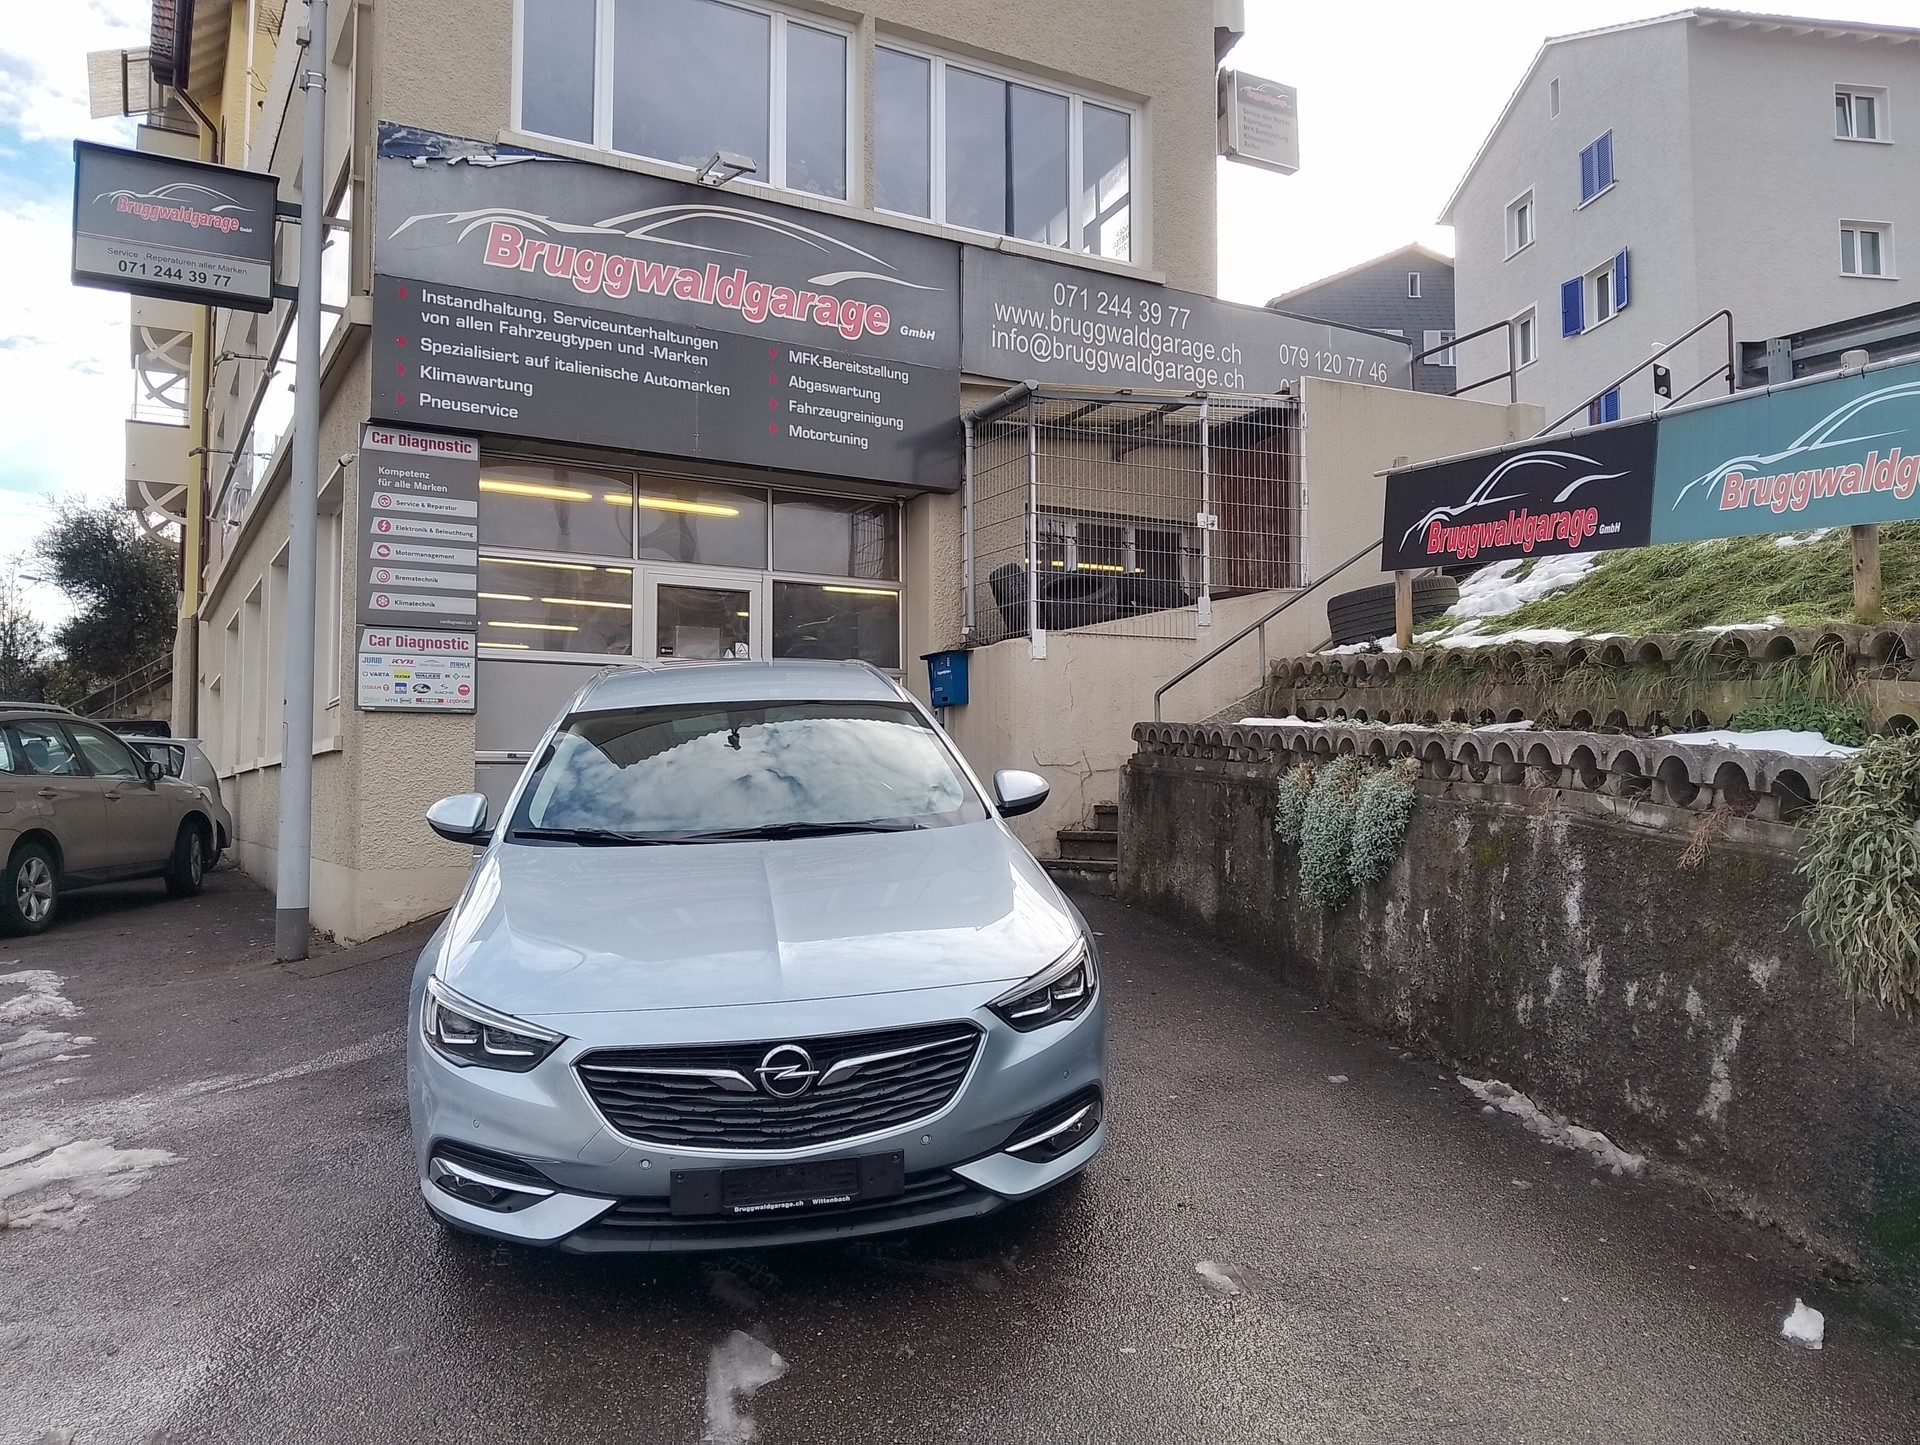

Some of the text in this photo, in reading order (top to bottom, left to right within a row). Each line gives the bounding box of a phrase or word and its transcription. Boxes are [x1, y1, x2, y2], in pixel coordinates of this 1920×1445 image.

[117, 194, 239, 233] Bruggwaldgarage
[107, 247, 138, 258] Service
[198, 262, 216, 270] aller
[218, 264, 248, 275] Marken
[118, 260, 232, 287] 071 244 39 77
[483, 221, 936, 340] Bruggwaldgarage GmbH
[422, 288, 719, 350] Instandhaltung, Serviceunterhaltungen
[1054, 282, 1191, 330] 071 244 39 77
[421, 312, 708, 367] von allen Fahrzeugtypen und -Marken
[994, 302, 1242, 365] www.bruggwaldgarage.ch
[420, 338, 730, 396] Spezialisiert auf italienische Automarken
[788, 350, 909, 384] MFK-Bereitstellung
[991, 325, 1246, 390] info@bruggwaldgarage.ch
[1280, 344, 1388, 383] 079 120 77 46
[420, 365, 533, 396] Klimawartung
[788, 376, 880, 403] Abgaswartung
[420, 392, 518, 418] Pneuservice
[788, 400, 904, 430] Fahrzeugreinigung
[372, 431, 472, 454] Car Diagnostic
[788, 424, 868, 449] Motortuning
[378, 466, 430, 479] Kompetenz
[378, 478, 448, 492] für alle Marken
[1719, 446, 1920, 514] Bruggwaldg
[396, 500, 420, 508] Service
[427, 502, 458, 511] Reparatur
[396, 524, 428, 533] Elektronik
[435, 528, 474, 538] Beleuchtung
[1427, 507, 1621, 559] Bruggwaldgarage GmbH
[396, 550, 455, 560] Motormanagement
[394, 574, 438, 583] Bremstechnik
[369, 634, 469, 651] Car Diagnostic
[734, 1195, 850, 1212] Bruggwaldgarage.ch Wittenbach
